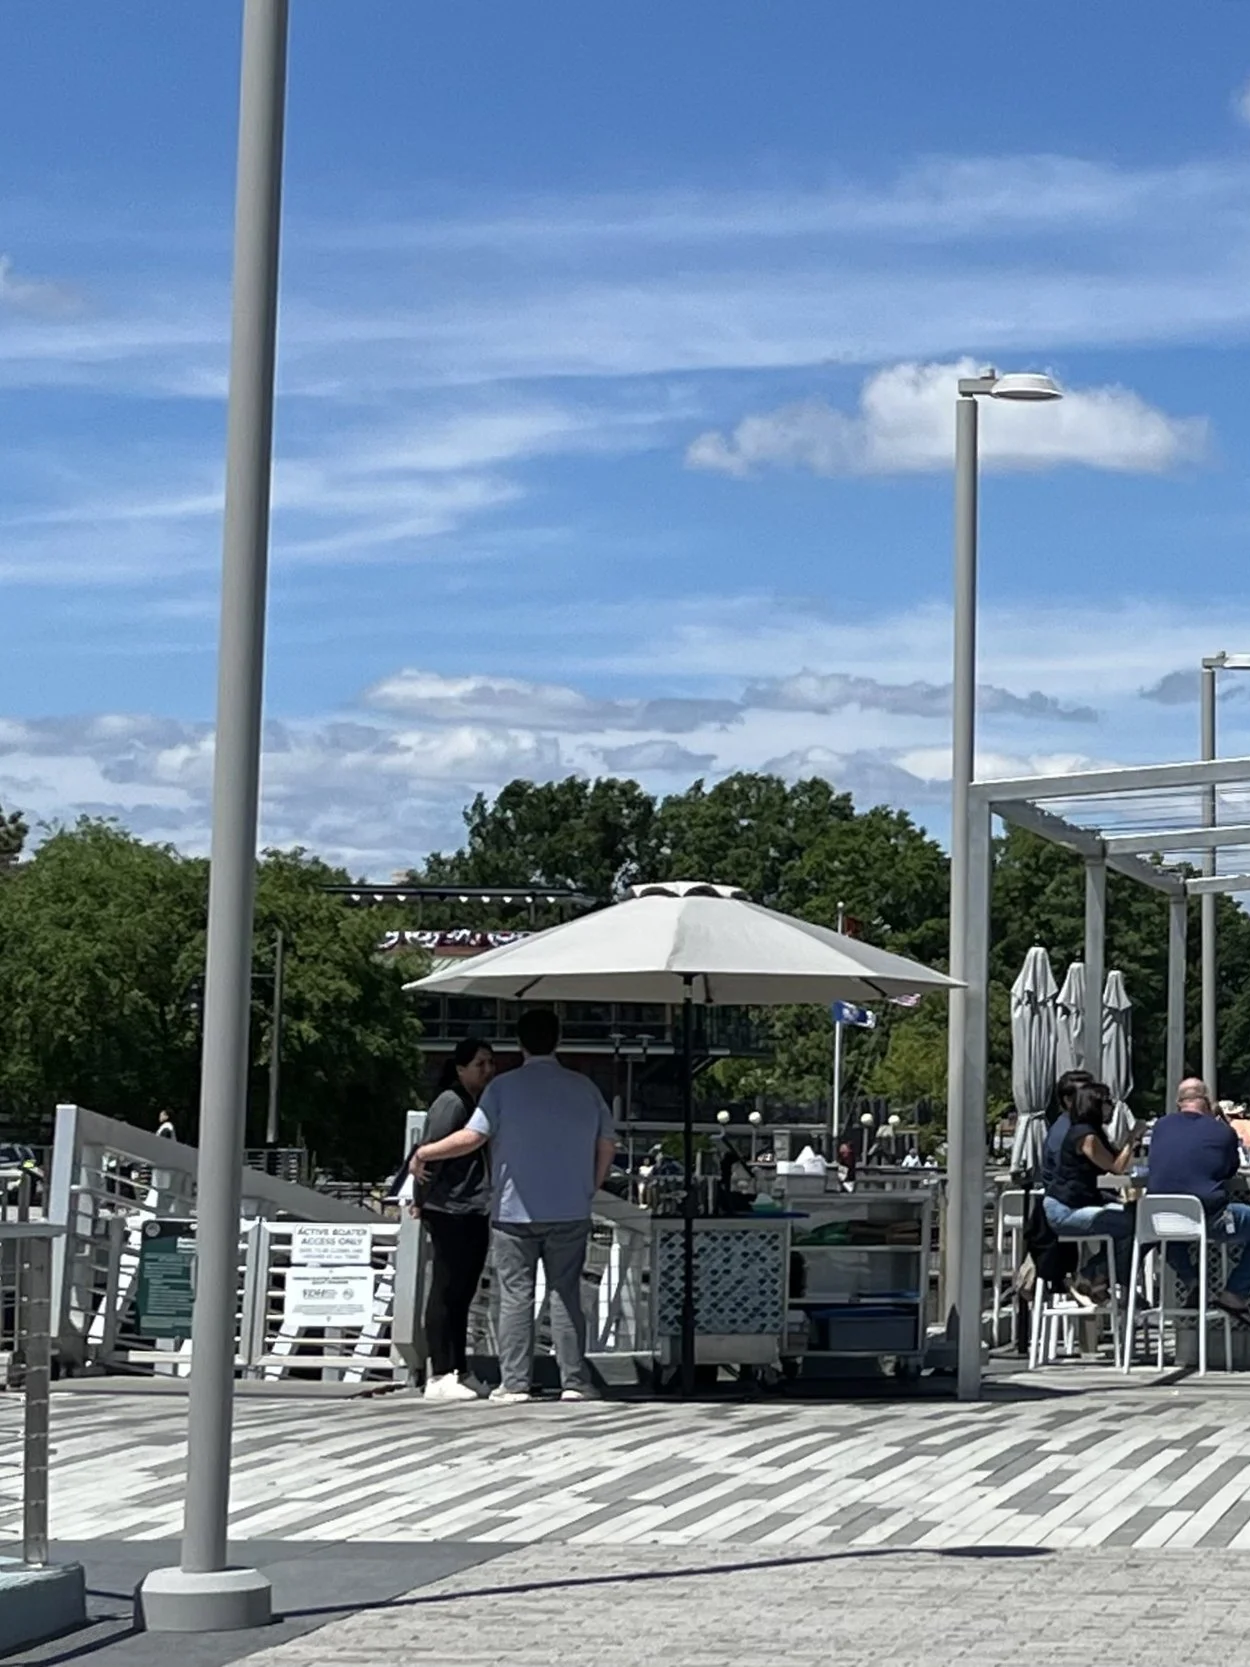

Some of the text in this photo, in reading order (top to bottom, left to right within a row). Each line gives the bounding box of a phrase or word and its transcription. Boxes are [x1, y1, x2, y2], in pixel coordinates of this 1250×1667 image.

[297, 1227, 367, 1236] ACTIVE BOATER
[301, 1237, 363, 1246] ACCESS ONLY
